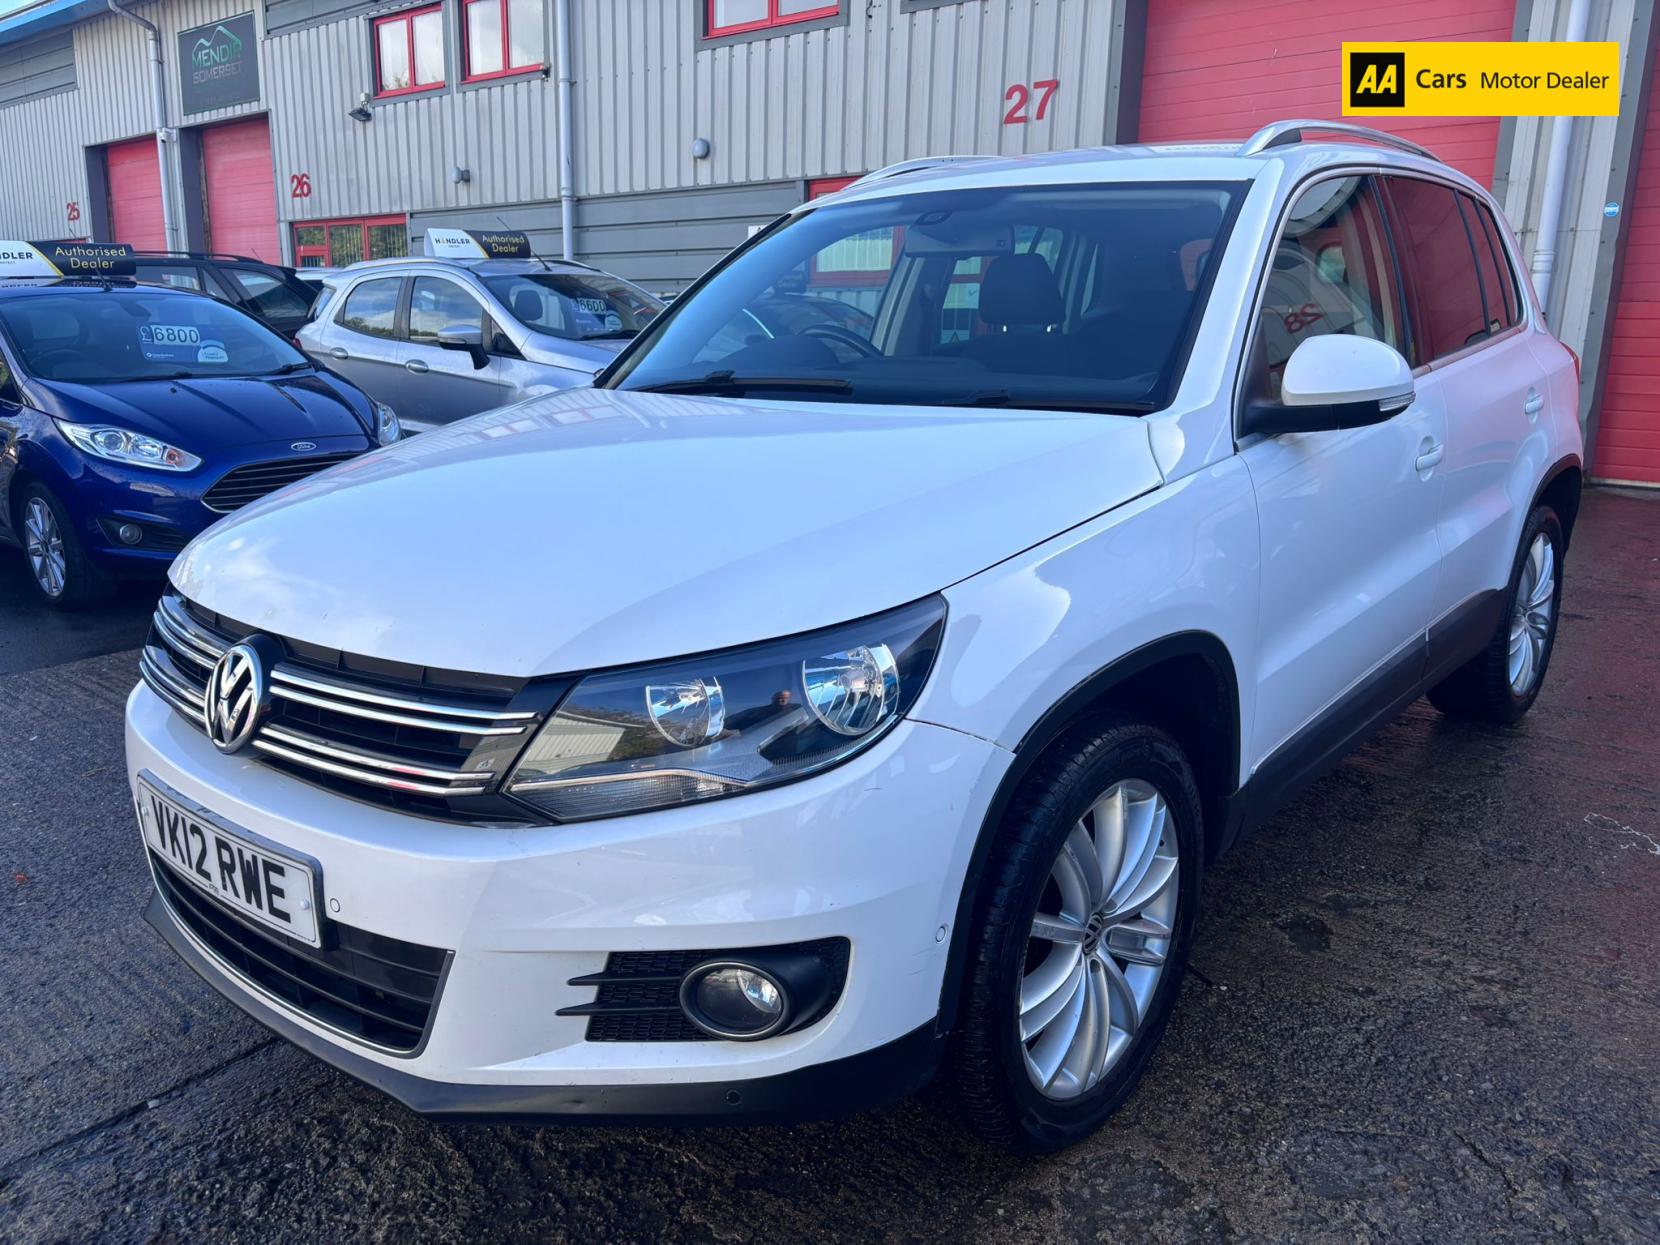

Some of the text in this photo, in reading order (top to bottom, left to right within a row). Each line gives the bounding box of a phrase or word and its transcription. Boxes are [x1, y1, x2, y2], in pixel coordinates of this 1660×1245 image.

[193, 61, 242, 84] SOMERSET
[1003, 80, 1058, 124] 27
[291, 173, 312, 198] 26
[66, 202, 80, 221] 25
[482, 234, 525, 244] Authorised
[492, 243, 519, 253] Dealer
[55, 246, 127, 257] Authorised
[70, 257, 115, 269] Dealer
[151, 795, 291, 924] VK12 RWE
